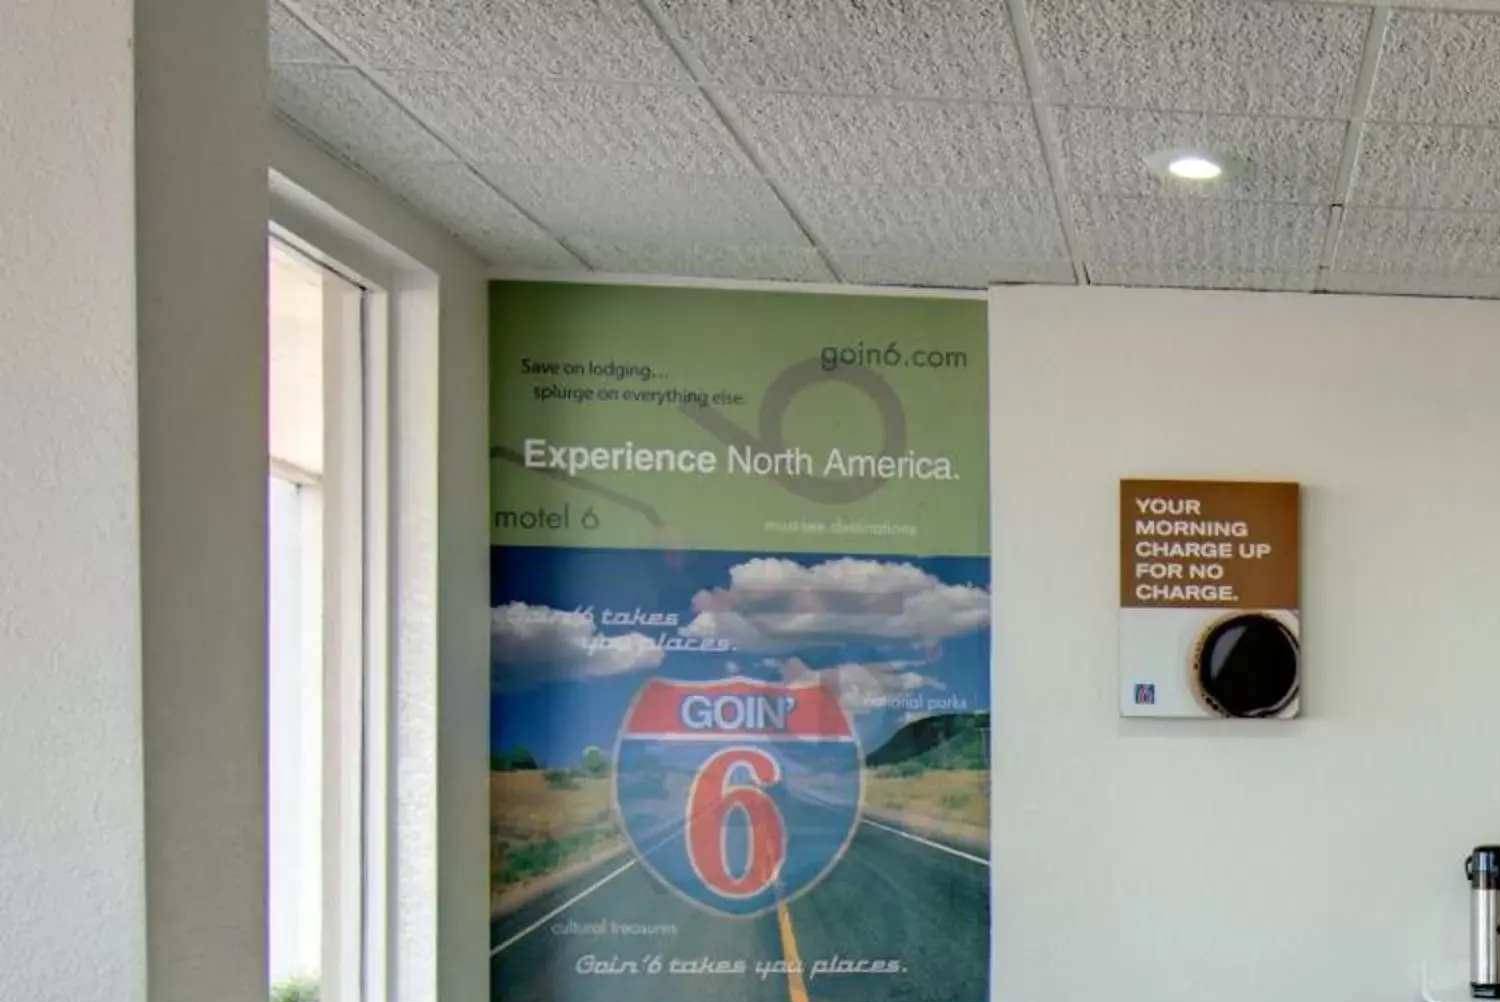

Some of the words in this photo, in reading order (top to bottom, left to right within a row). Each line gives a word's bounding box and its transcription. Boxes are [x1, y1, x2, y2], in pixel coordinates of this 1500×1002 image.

[821, 342, 967, 371] goin6.com
[520, 358, 560, 375] Save
[563, 362, 585, 376] on
[533, 384, 594, 402] splurge
[596, 386, 619, 401] on
[622, 387, 709, 407] everything
[524, 438, 717, 476] Experience
[727, 444, 812, 475] North
[823, 447, 960, 480] America.
[494, 503, 569, 529] motel
[581, 505, 599, 529] 6
[1135, 498, 1201, 515] YOUR
[1135, 520, 1249, 537] MORNING
[1135, 541, 1233, 558] CHARGE
[1238, 543, 1271, 559] UP
[1135, 563, 1183, 579] FOR
[1188, 563, 1224, 580] NO
[1135, 584, 1239, 601] CHARGE.
[601, 607, 679, 626] takes
[681, 693, 796, 730] GOIN'
[684, 746, 786, 898] 6
[551, 918, 606, 935] cultural
[668, 954, 747, 975] takes
[754, 957, 804, 982] you
